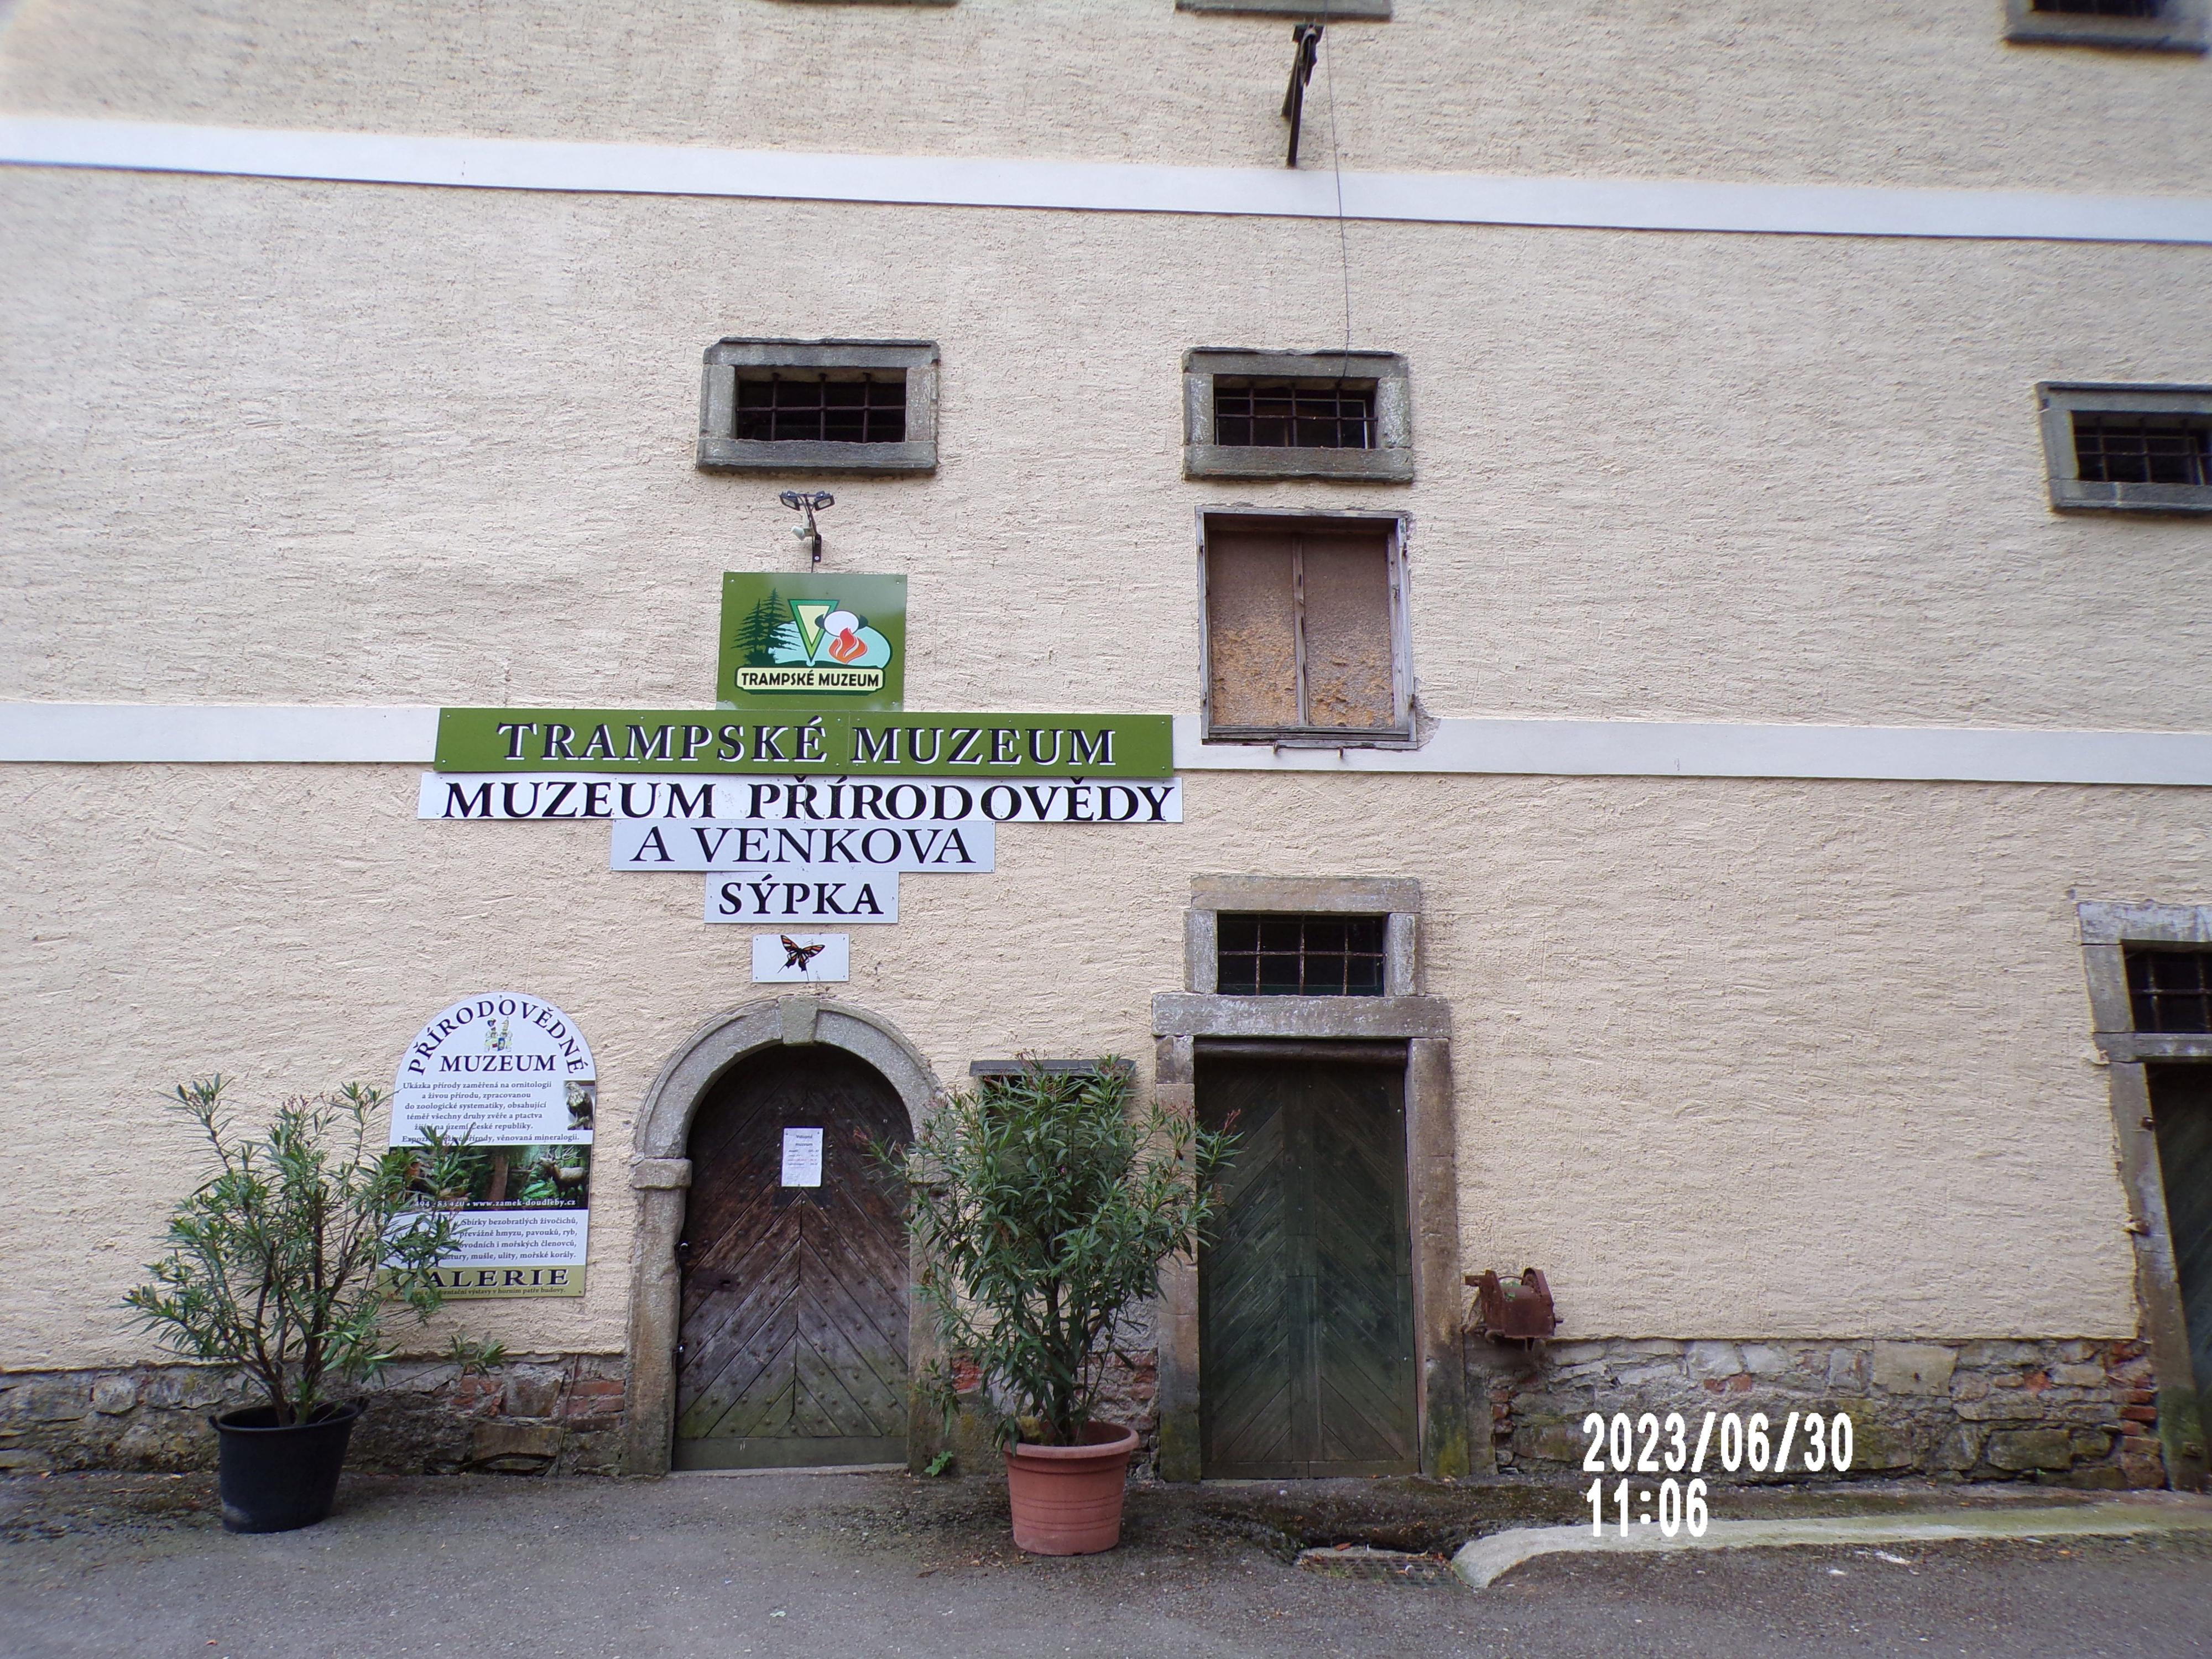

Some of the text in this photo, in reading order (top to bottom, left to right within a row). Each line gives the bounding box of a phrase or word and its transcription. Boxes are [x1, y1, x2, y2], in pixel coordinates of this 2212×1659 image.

[742, 670, 879, 687] TRAMPSKÉ MUZEUM
[496, 716, 1117, 766] TRAMPSKÉ MUZEUM
[441, 775, 1175, 821] MUZEUM PŘÍRODOVĚDY
[629, 826, 977, 864] A VENKOVA
[719, 873, 884, 915] SÝPKA
[408, 998, 588, 1076] PŘÍRODOVĚDNÉ
[439, 1055, 557, 1072] MUZEUM
[432, 1082, 461, 1090] přírody
[511, 1081, 552, 1089] ornitologii
[416, 1102, 457, 1110] zoologické
[459, 1102, 505, 1110] systematiky,
[507, 1101, 547, 1110] obsahující
[431, 1112, 461, 1120] všechny
[463, 1113, 485, 1121] druhy
[494, 1123, 533, 1131] republiky.
[468, 1134, 495, 1142] řírody,
[534, 1133, 580, 1142] mineralogii.
[461, 1217, 578, 1227] Sbírky bezobratlých živočichů,
[460, 1228, 577, 1238] převážně hmyzu, pavouků, ryb,
[502, 1240, 539, 1248] mořských
[541, 1239, 577, 1248] členovců,
[550, 1251, 576, 1259] korály.
